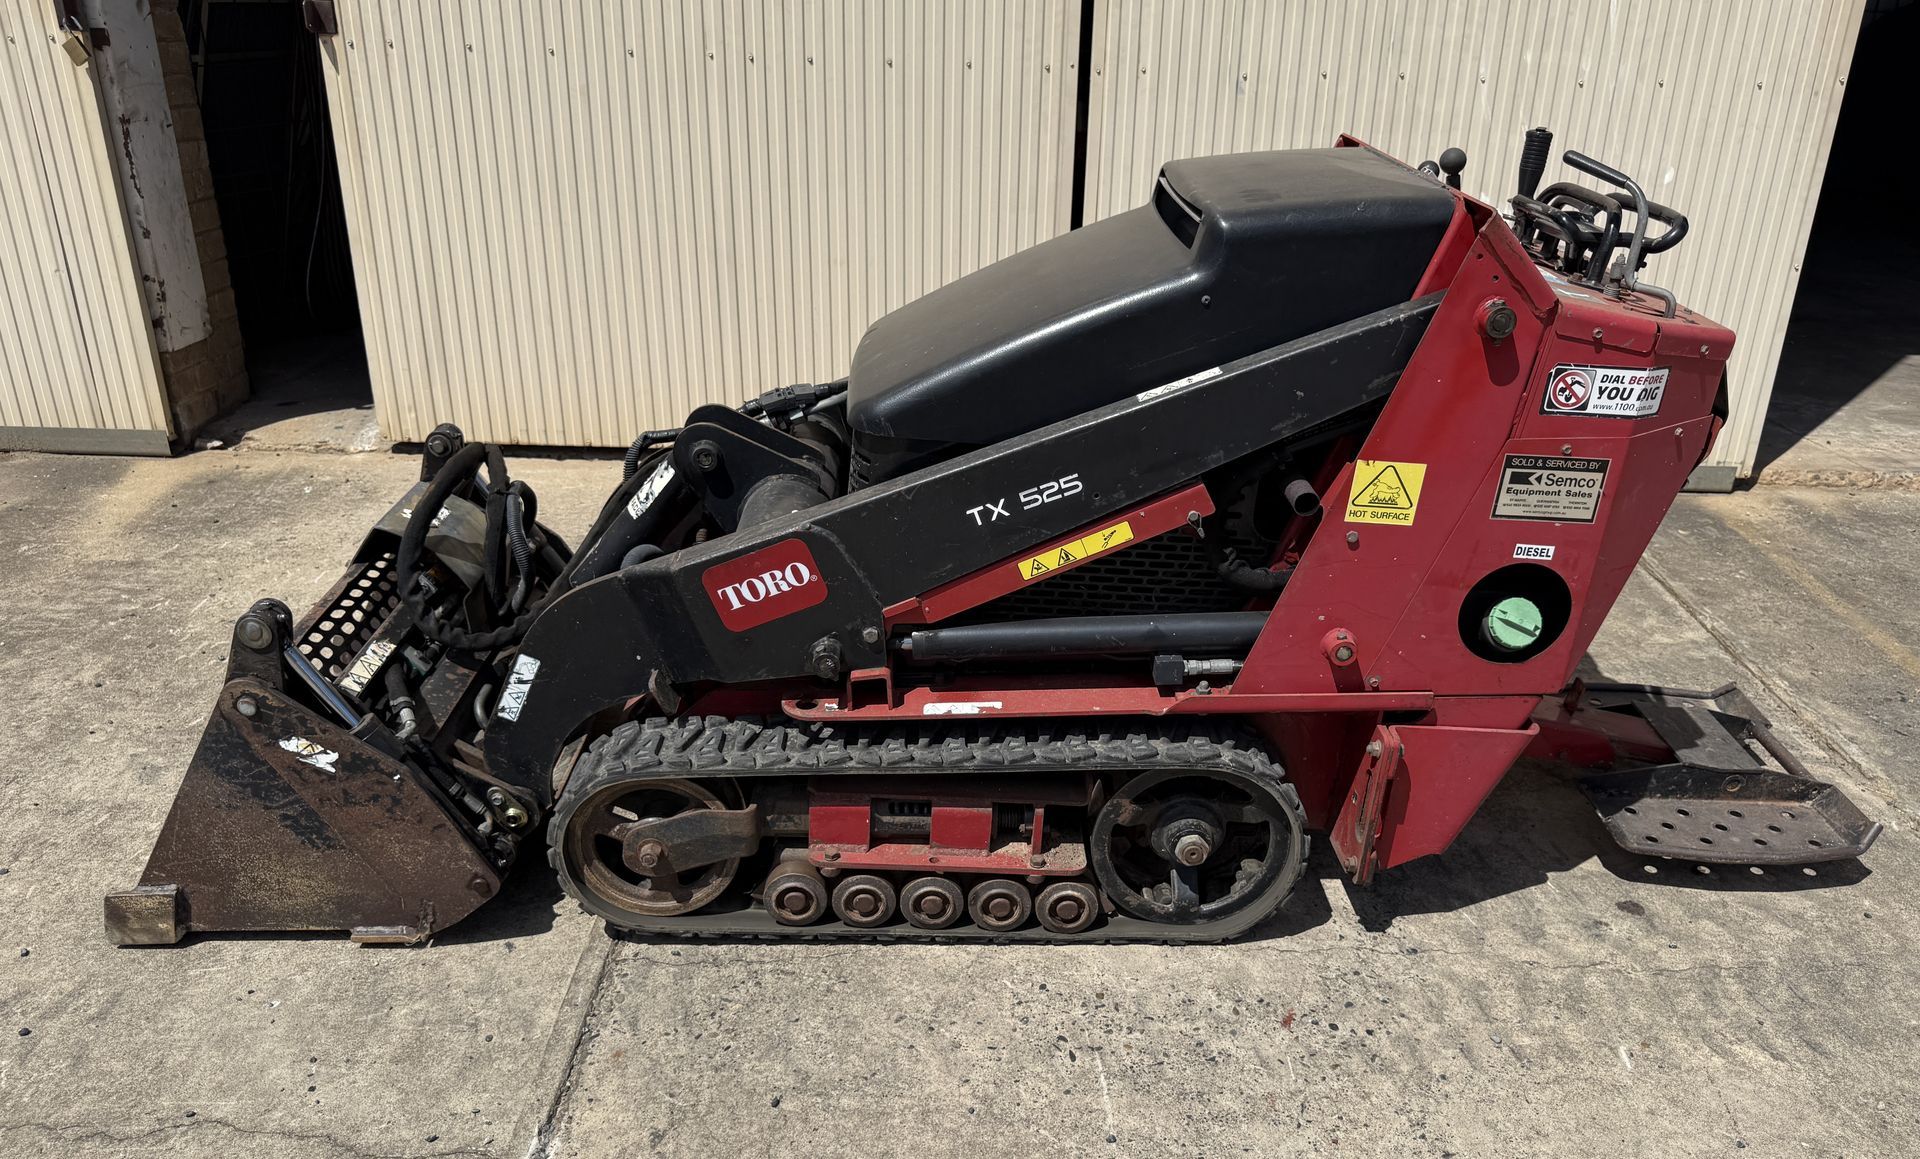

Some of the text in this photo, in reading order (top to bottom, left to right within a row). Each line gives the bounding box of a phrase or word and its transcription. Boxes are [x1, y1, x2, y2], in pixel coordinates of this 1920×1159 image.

[1600, 374, 1665, 385] DIAL BEFORE
[1597, 386, 1660, 402] YOU DIG
[1592, 402, 1654, 412] www.1100.com.au
[1511, 457, 1601, 470] SOLD & SERVICED BY
[1544, 473, 1596, 489] Semco
[1506, 487, 1593, 498] Equipment Sales
[966, 473, 1083, 526] TX 525
[1348, 510, 1411, 521] HOT SURFACE
[1515, 546, 1551, 558] DIESEL
[716, 562, 811, 611] TORO
